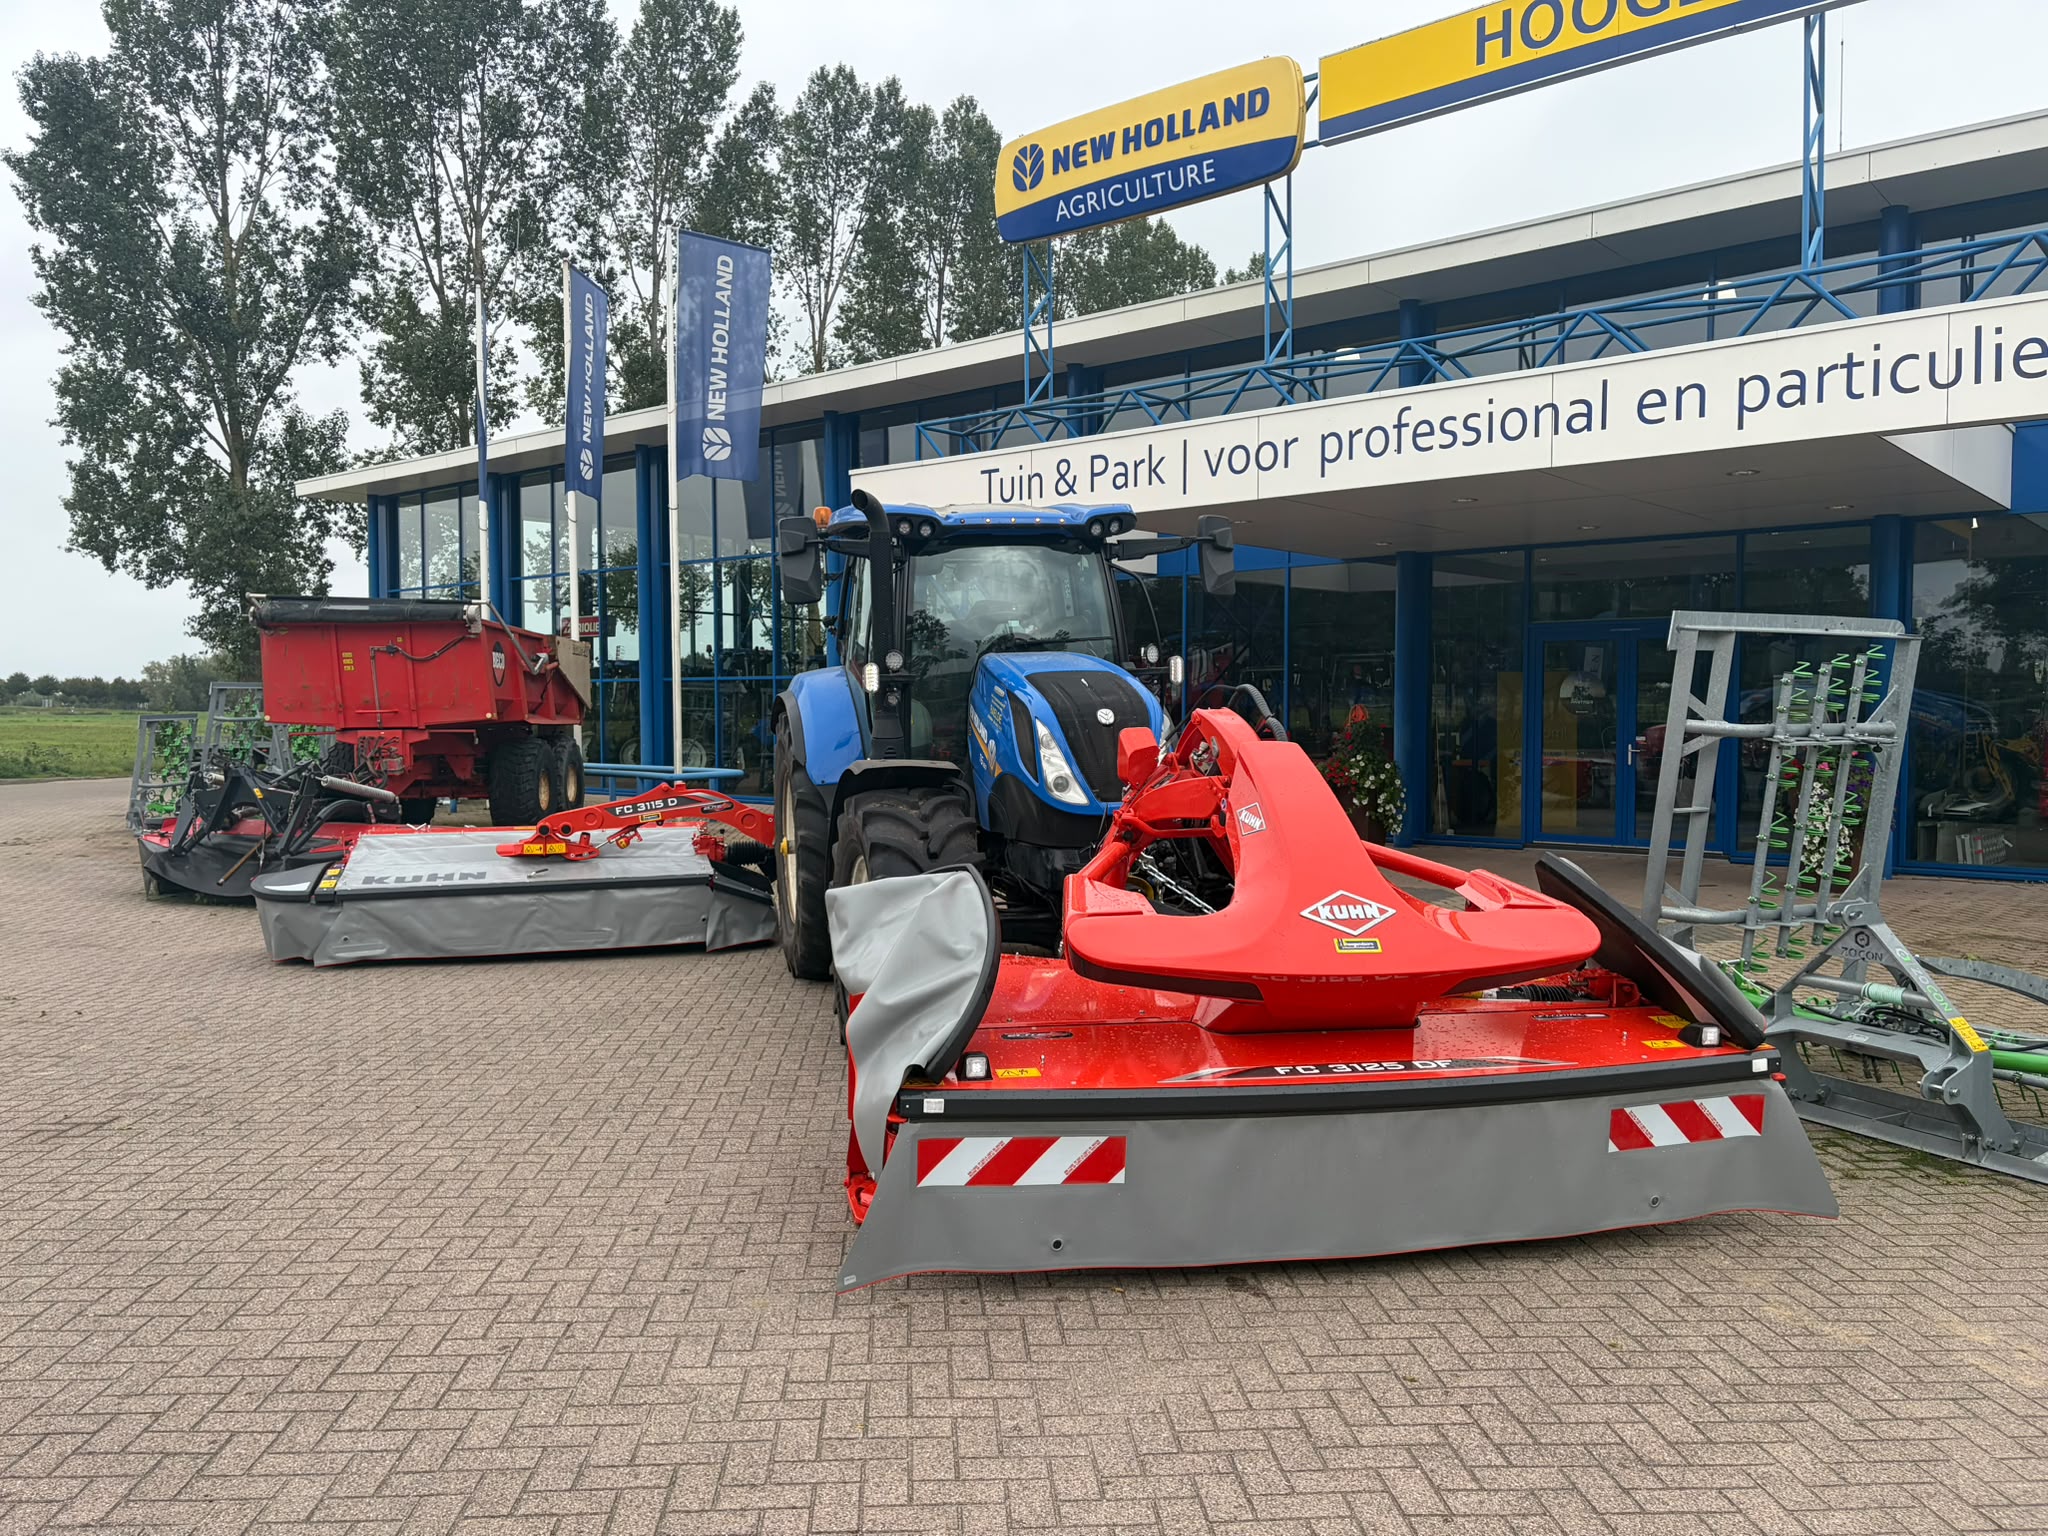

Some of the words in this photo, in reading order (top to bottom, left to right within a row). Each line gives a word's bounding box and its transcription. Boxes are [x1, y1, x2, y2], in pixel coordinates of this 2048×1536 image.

[1052, 132, 1116, 175] NEW
[1122, 86, 1270, 155] HOLLAND
[1055, 159, 1216, 222] AGRICULTURE
[711, 255, 734, 364] HOLLAND
[584, 293, 594, 393] HOLLAND
[582, 395, 593, 443] NEW
[706, 367, 728, 421] NEW
[981, 467, 1043, 504] Tuin
[1054, 458, 1078, 496] &
[1090, 444, 1166, 493] Park
[1204, 437, 1299, 477] voor
[1320, 380, 1608, 478] professional
[1636, 383, 1707, 425] en
[1737, 325, 2048, 430] particulie
[615, 805, 633, 816] FC
[637, 800, 664, 813] 3115
[667, 797, 678, 807] D
[1239, 809, 1262, 830] KUHN
[361, 871, 487, 885] KUHN
[1317, 903, 1382, 920] KUHN
[1273, 1065, 1321, 1076] FC
[1332, 1061, 1404, 1073] 3125
[1411, 1059, 1455, 1070] DF
